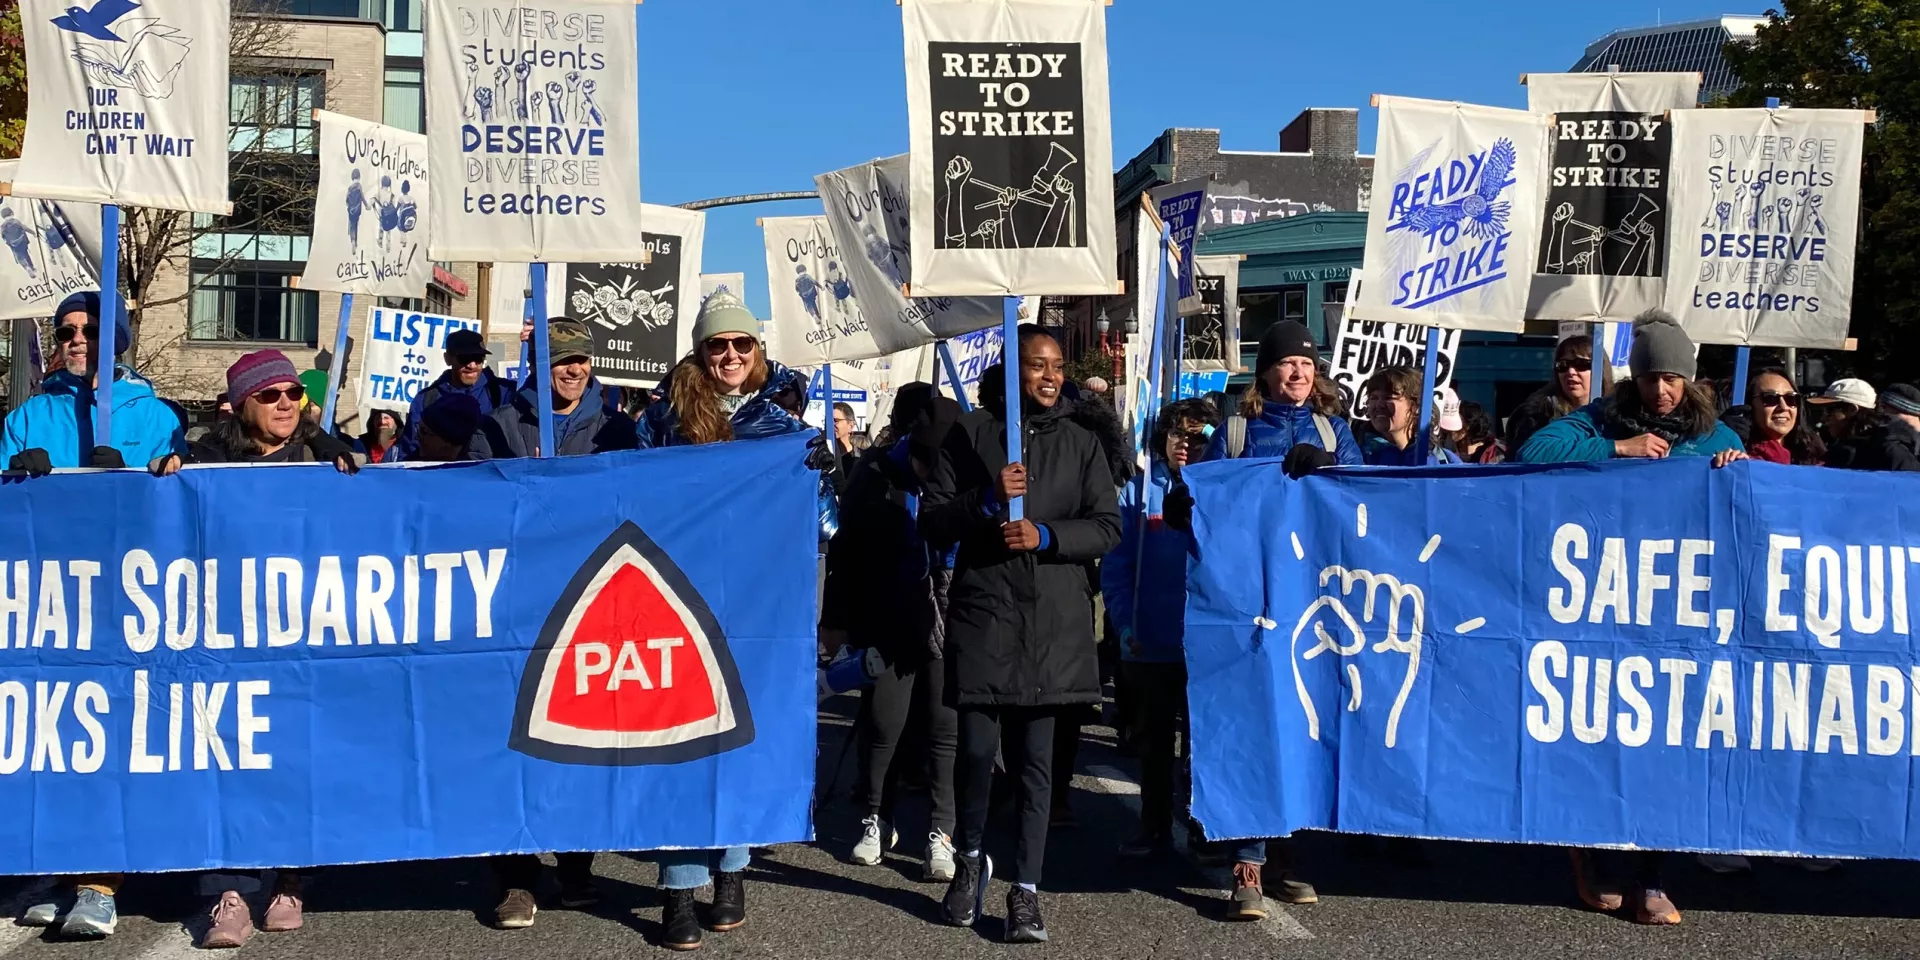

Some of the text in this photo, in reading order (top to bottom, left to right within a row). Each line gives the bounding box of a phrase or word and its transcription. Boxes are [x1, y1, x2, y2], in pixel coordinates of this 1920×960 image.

[458, 7, 604, 43] DIVERSE
[462, 38, 605, 70] students
[942, 53, 1066, 77] READY
[88, 86, 118, 106] OUR
[980, 82, 1030, 107] TO
[940, 111, 1074, 136] STRIKE
[1559, 120, 1661, 141] READY
[145, 134, 194, 157] WAIT
[462, 124, 604, 156] DESERVE
[1587, 143, 1626, 164] TO
[1709, 134, 1837, 164] DIVERSE
[346, 130, 427, 181] Our children
[467, 157, 599, 186] DIVERSE
[1388, 150, 1486, 220] READY
[1553, 166, 1660, 188] STRIKE
[1708, 160, 1834, 187] students
[464, 185, 605, 215] teachers
[845, 189, 878, 222] Our
[1173, 214, 1184, 229] TO
[787, 238, 815, 262] Our
[1423, 221, 1460, 253] TO
[1701, 233, 1826, 261] DESERVE
[1289, 269, 1316, 280] WAX
[1392, 231, 1512, 305] STRIKE
[1699, 261, 1818, 287] DIVERSE
[1693, 284, 1819, 313] teachers
[607, 339, 633, 352] our
[963, 332, 986, 353] TO
[1394, 323, 1456, 350] FULY
[404, 348, 426, 364] to
[590, 355, 667, 373] mmunities
[959, 351, 1001, 379] TRIK
[401, 366, 429, 376] our
[370, 374, 429, 402] TEAC
[1548, 522, 1920, 649] SAFE, EQUI
[0, 547, 507, 654] HAT SOLIDARITY
[575, 637, 684, 696] PAT
[0, 669, 273, 775] OKS LIKE
